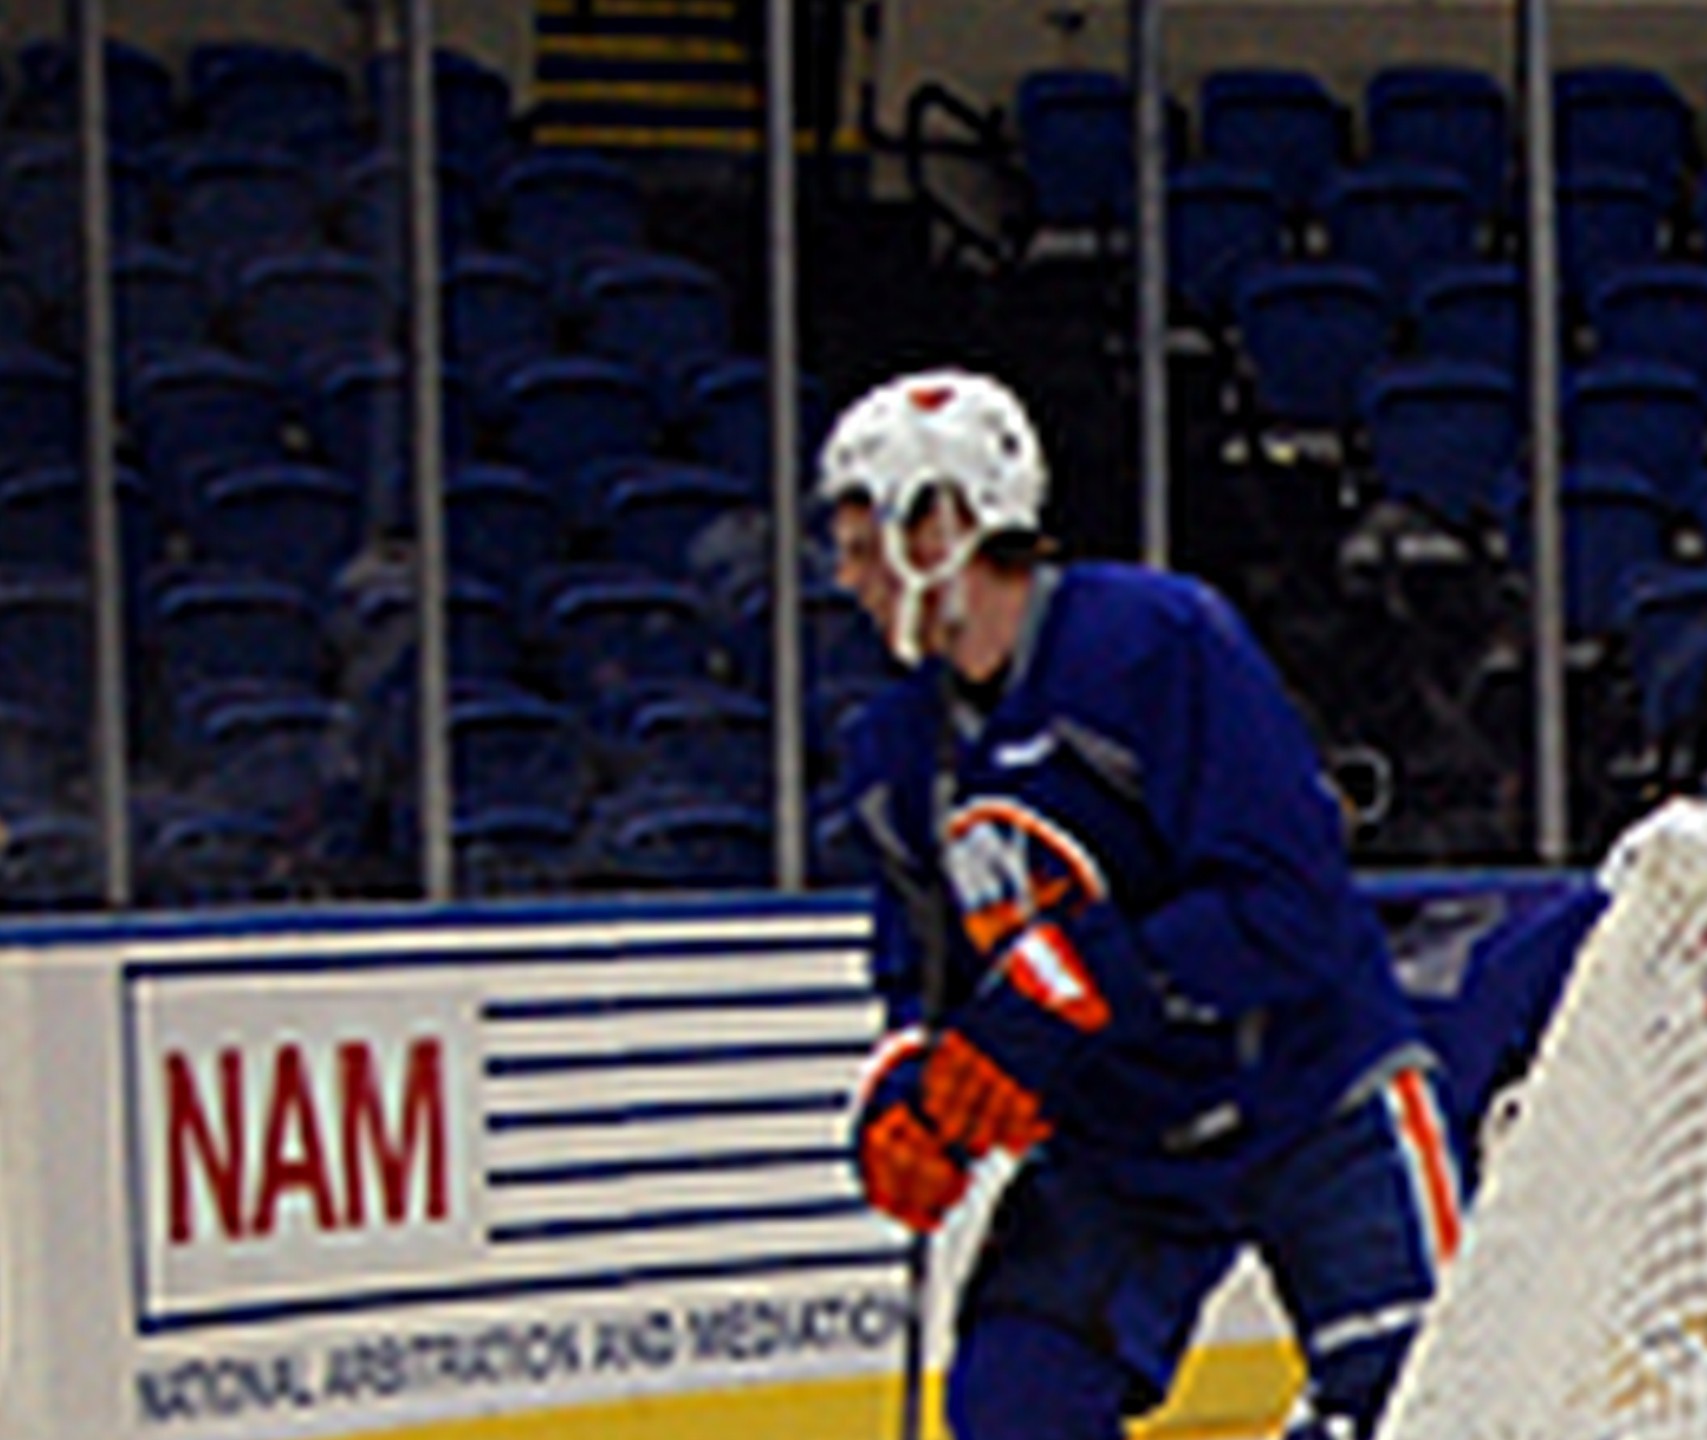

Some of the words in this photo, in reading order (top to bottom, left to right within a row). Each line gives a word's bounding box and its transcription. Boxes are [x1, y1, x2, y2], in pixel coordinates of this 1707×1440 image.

[163, 1036, 449, 1246] NAM
[136, 1352, 313, 1423] NATIONAL
[323, 1322, 584, 1400] ARBITRATION
[595, 1308, 676, 1372] AND
